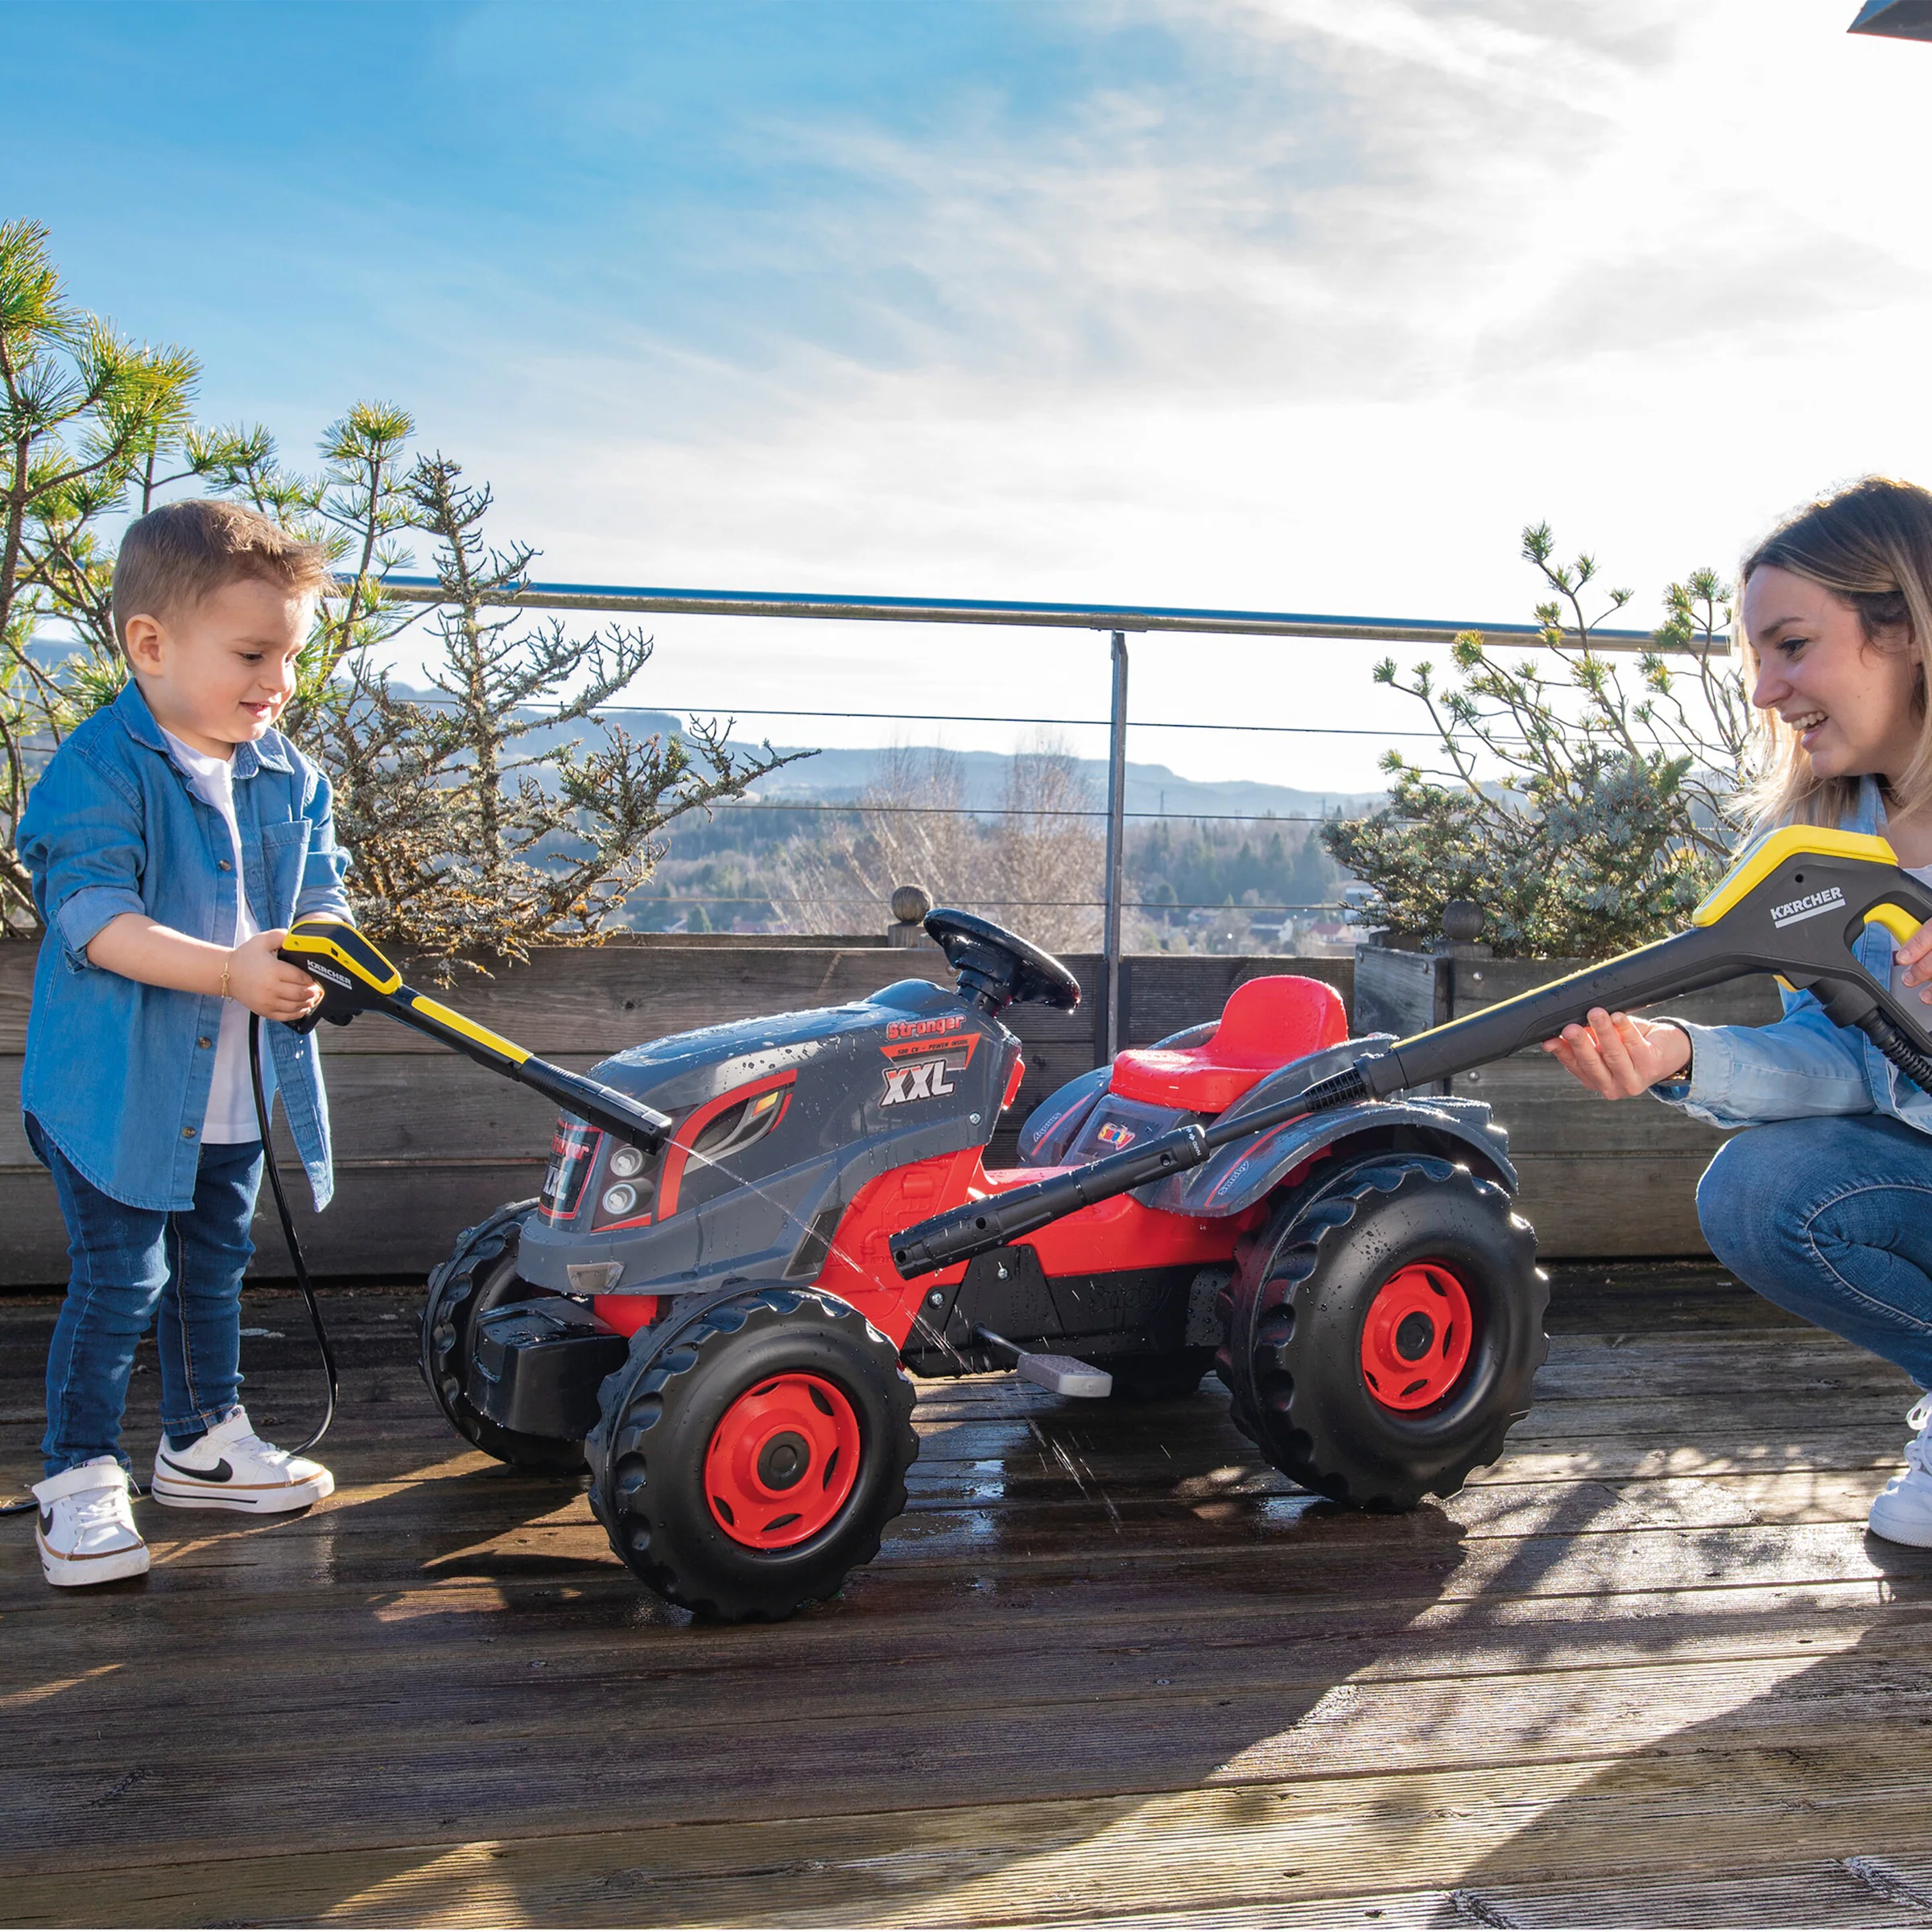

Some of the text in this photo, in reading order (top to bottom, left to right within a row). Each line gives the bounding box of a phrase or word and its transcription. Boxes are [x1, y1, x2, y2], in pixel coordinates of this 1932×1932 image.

[1770, 886, 1843, 920] KÄRCHER
[888, 1015, 965, 1039] Stronger
[881, 1060, 955, 1106] XXL
[1097, 1123, 1136, 1151] Smoby
[1217, 1160, 1249, 1196] Smoby
